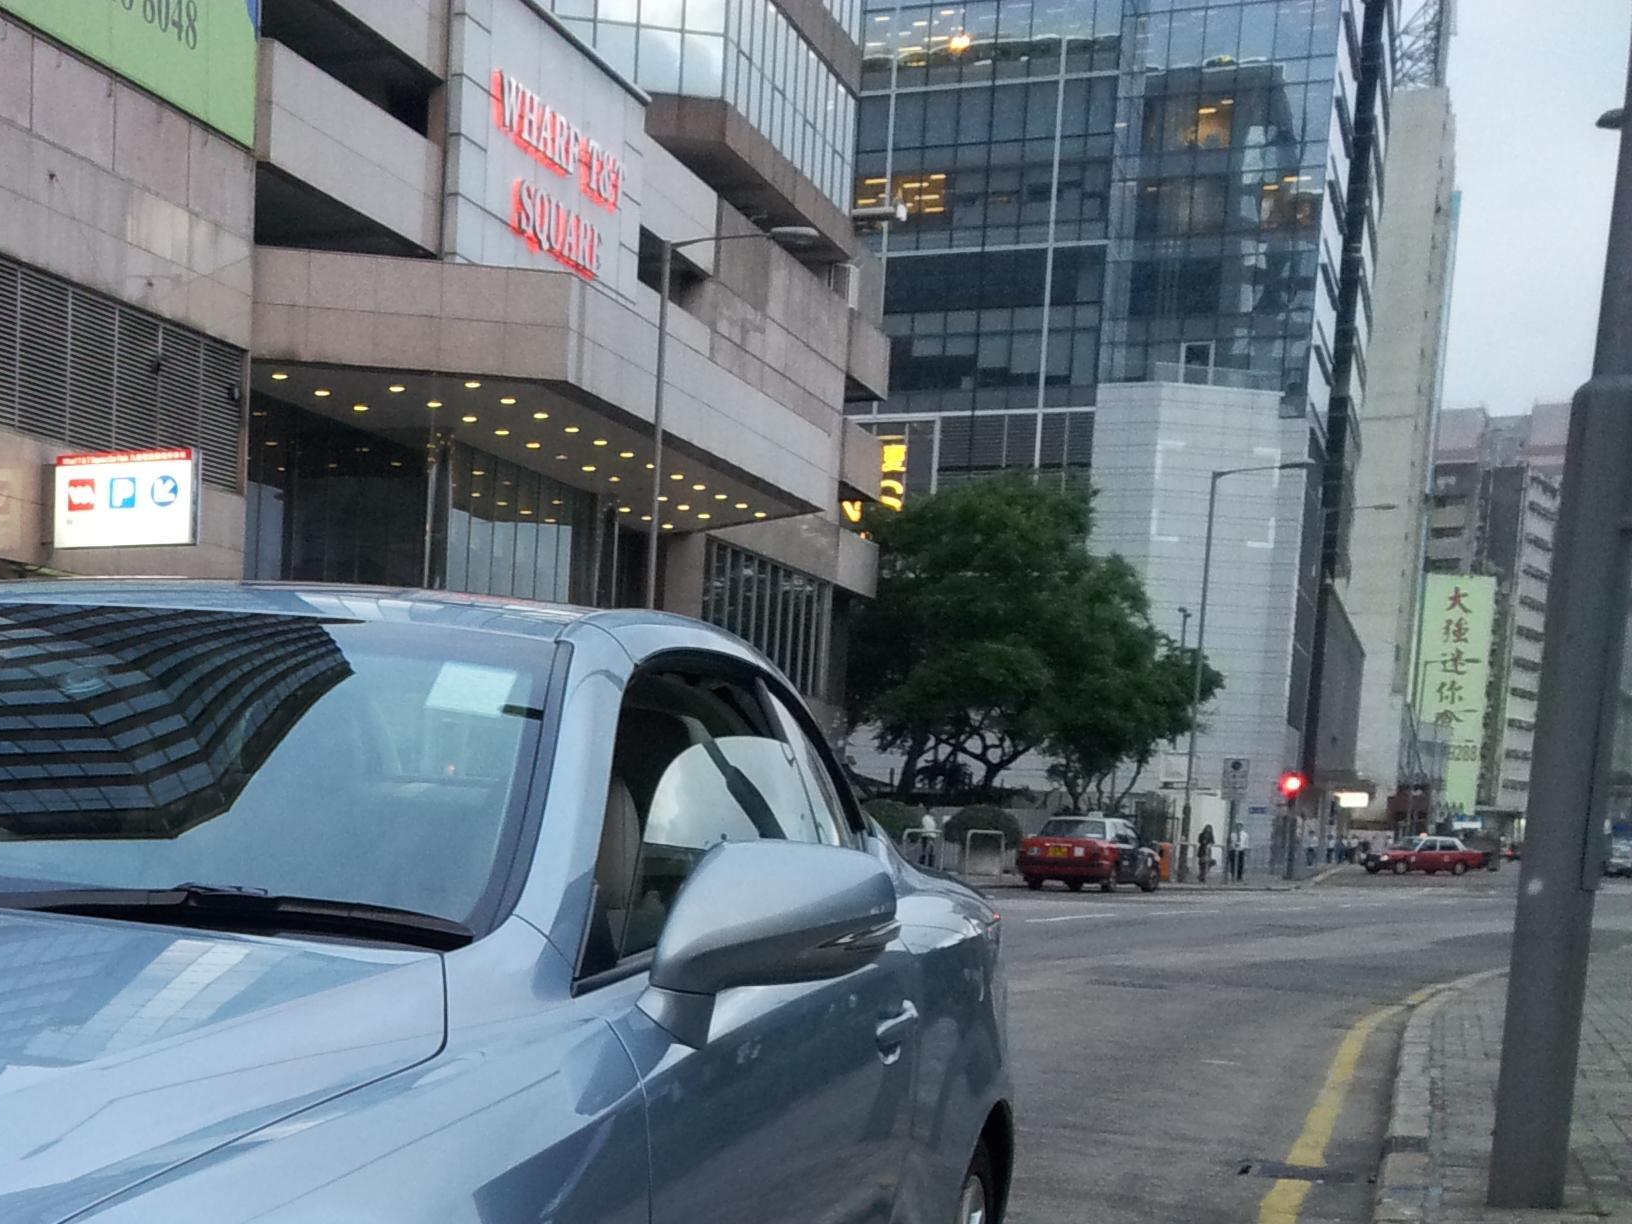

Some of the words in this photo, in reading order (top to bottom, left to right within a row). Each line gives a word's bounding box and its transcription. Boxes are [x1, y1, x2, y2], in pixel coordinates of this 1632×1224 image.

[498, 74, 580, 176] WHARF
[587, 138, 627, 207] T&T
[517, 178, 604, 272] SQUARE
